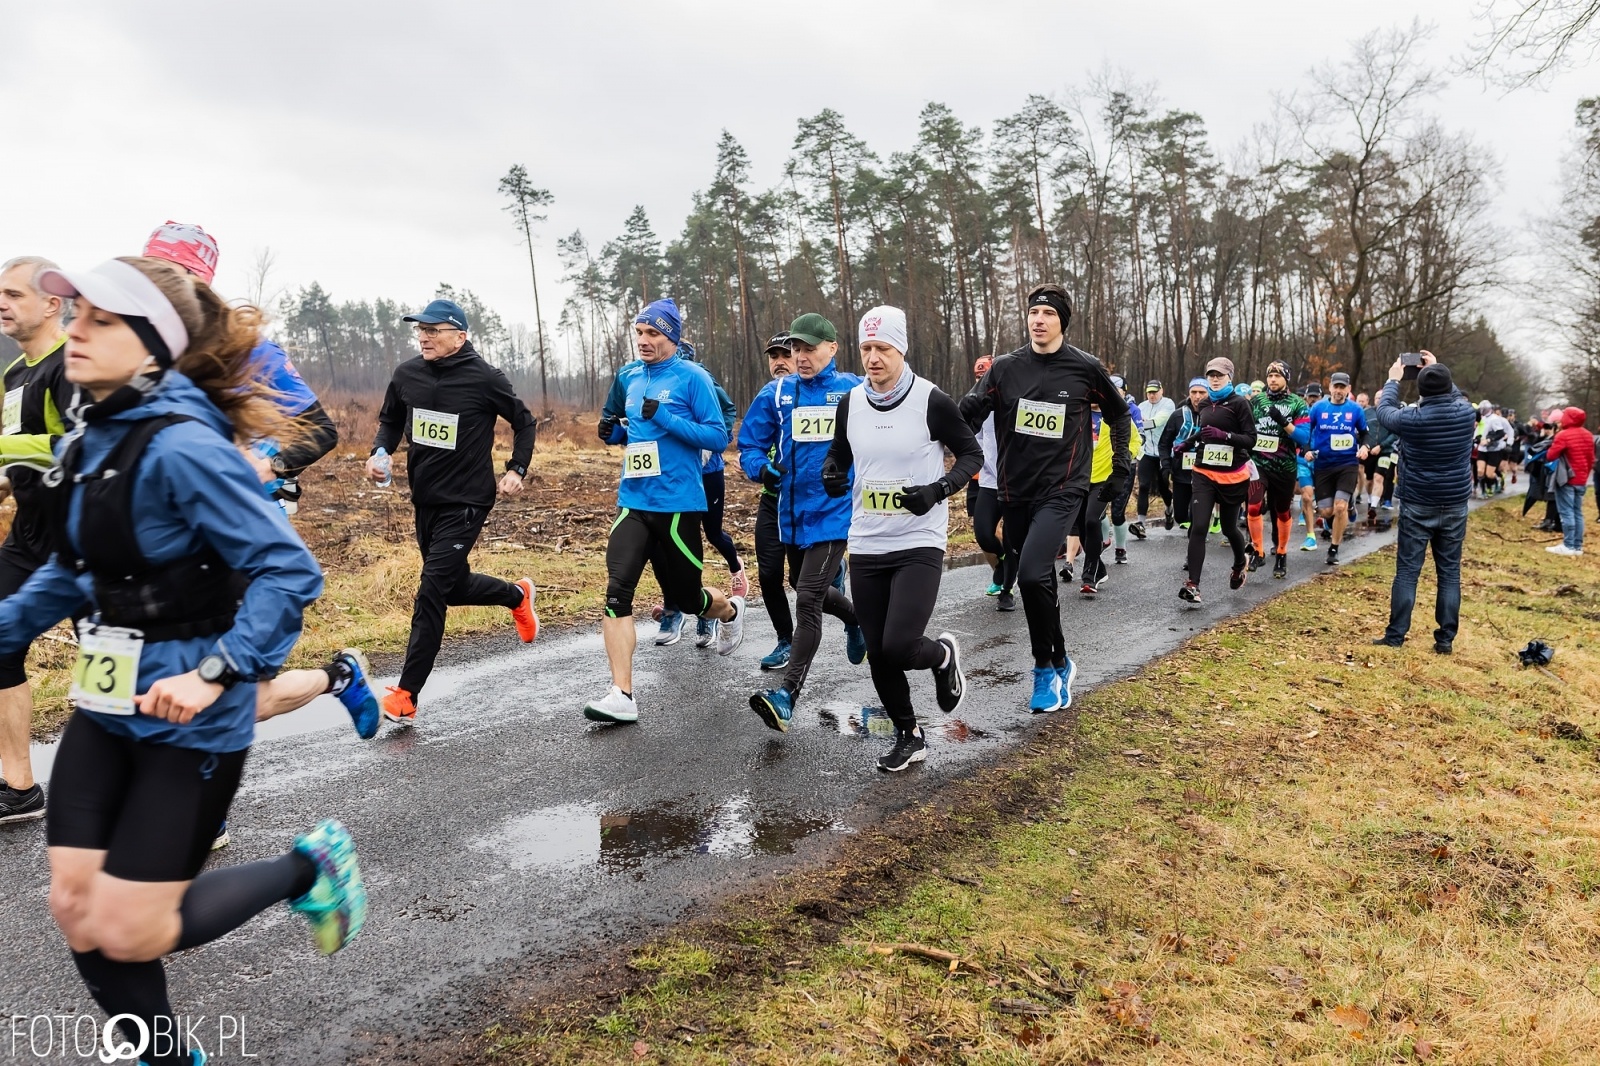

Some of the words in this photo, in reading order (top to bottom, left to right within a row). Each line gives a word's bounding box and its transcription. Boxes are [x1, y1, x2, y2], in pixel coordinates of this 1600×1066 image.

[800, 418, 835, 434] 217
[1023, 412, 1057, 431] 206
[419, 421, 449, 441] 165
[1257, 439, 1275, 449] 227
[1335, 439, 1351, 447] 212
[1208, 451, 1228, 462] 244
[868, 491, 904, 510] 176
